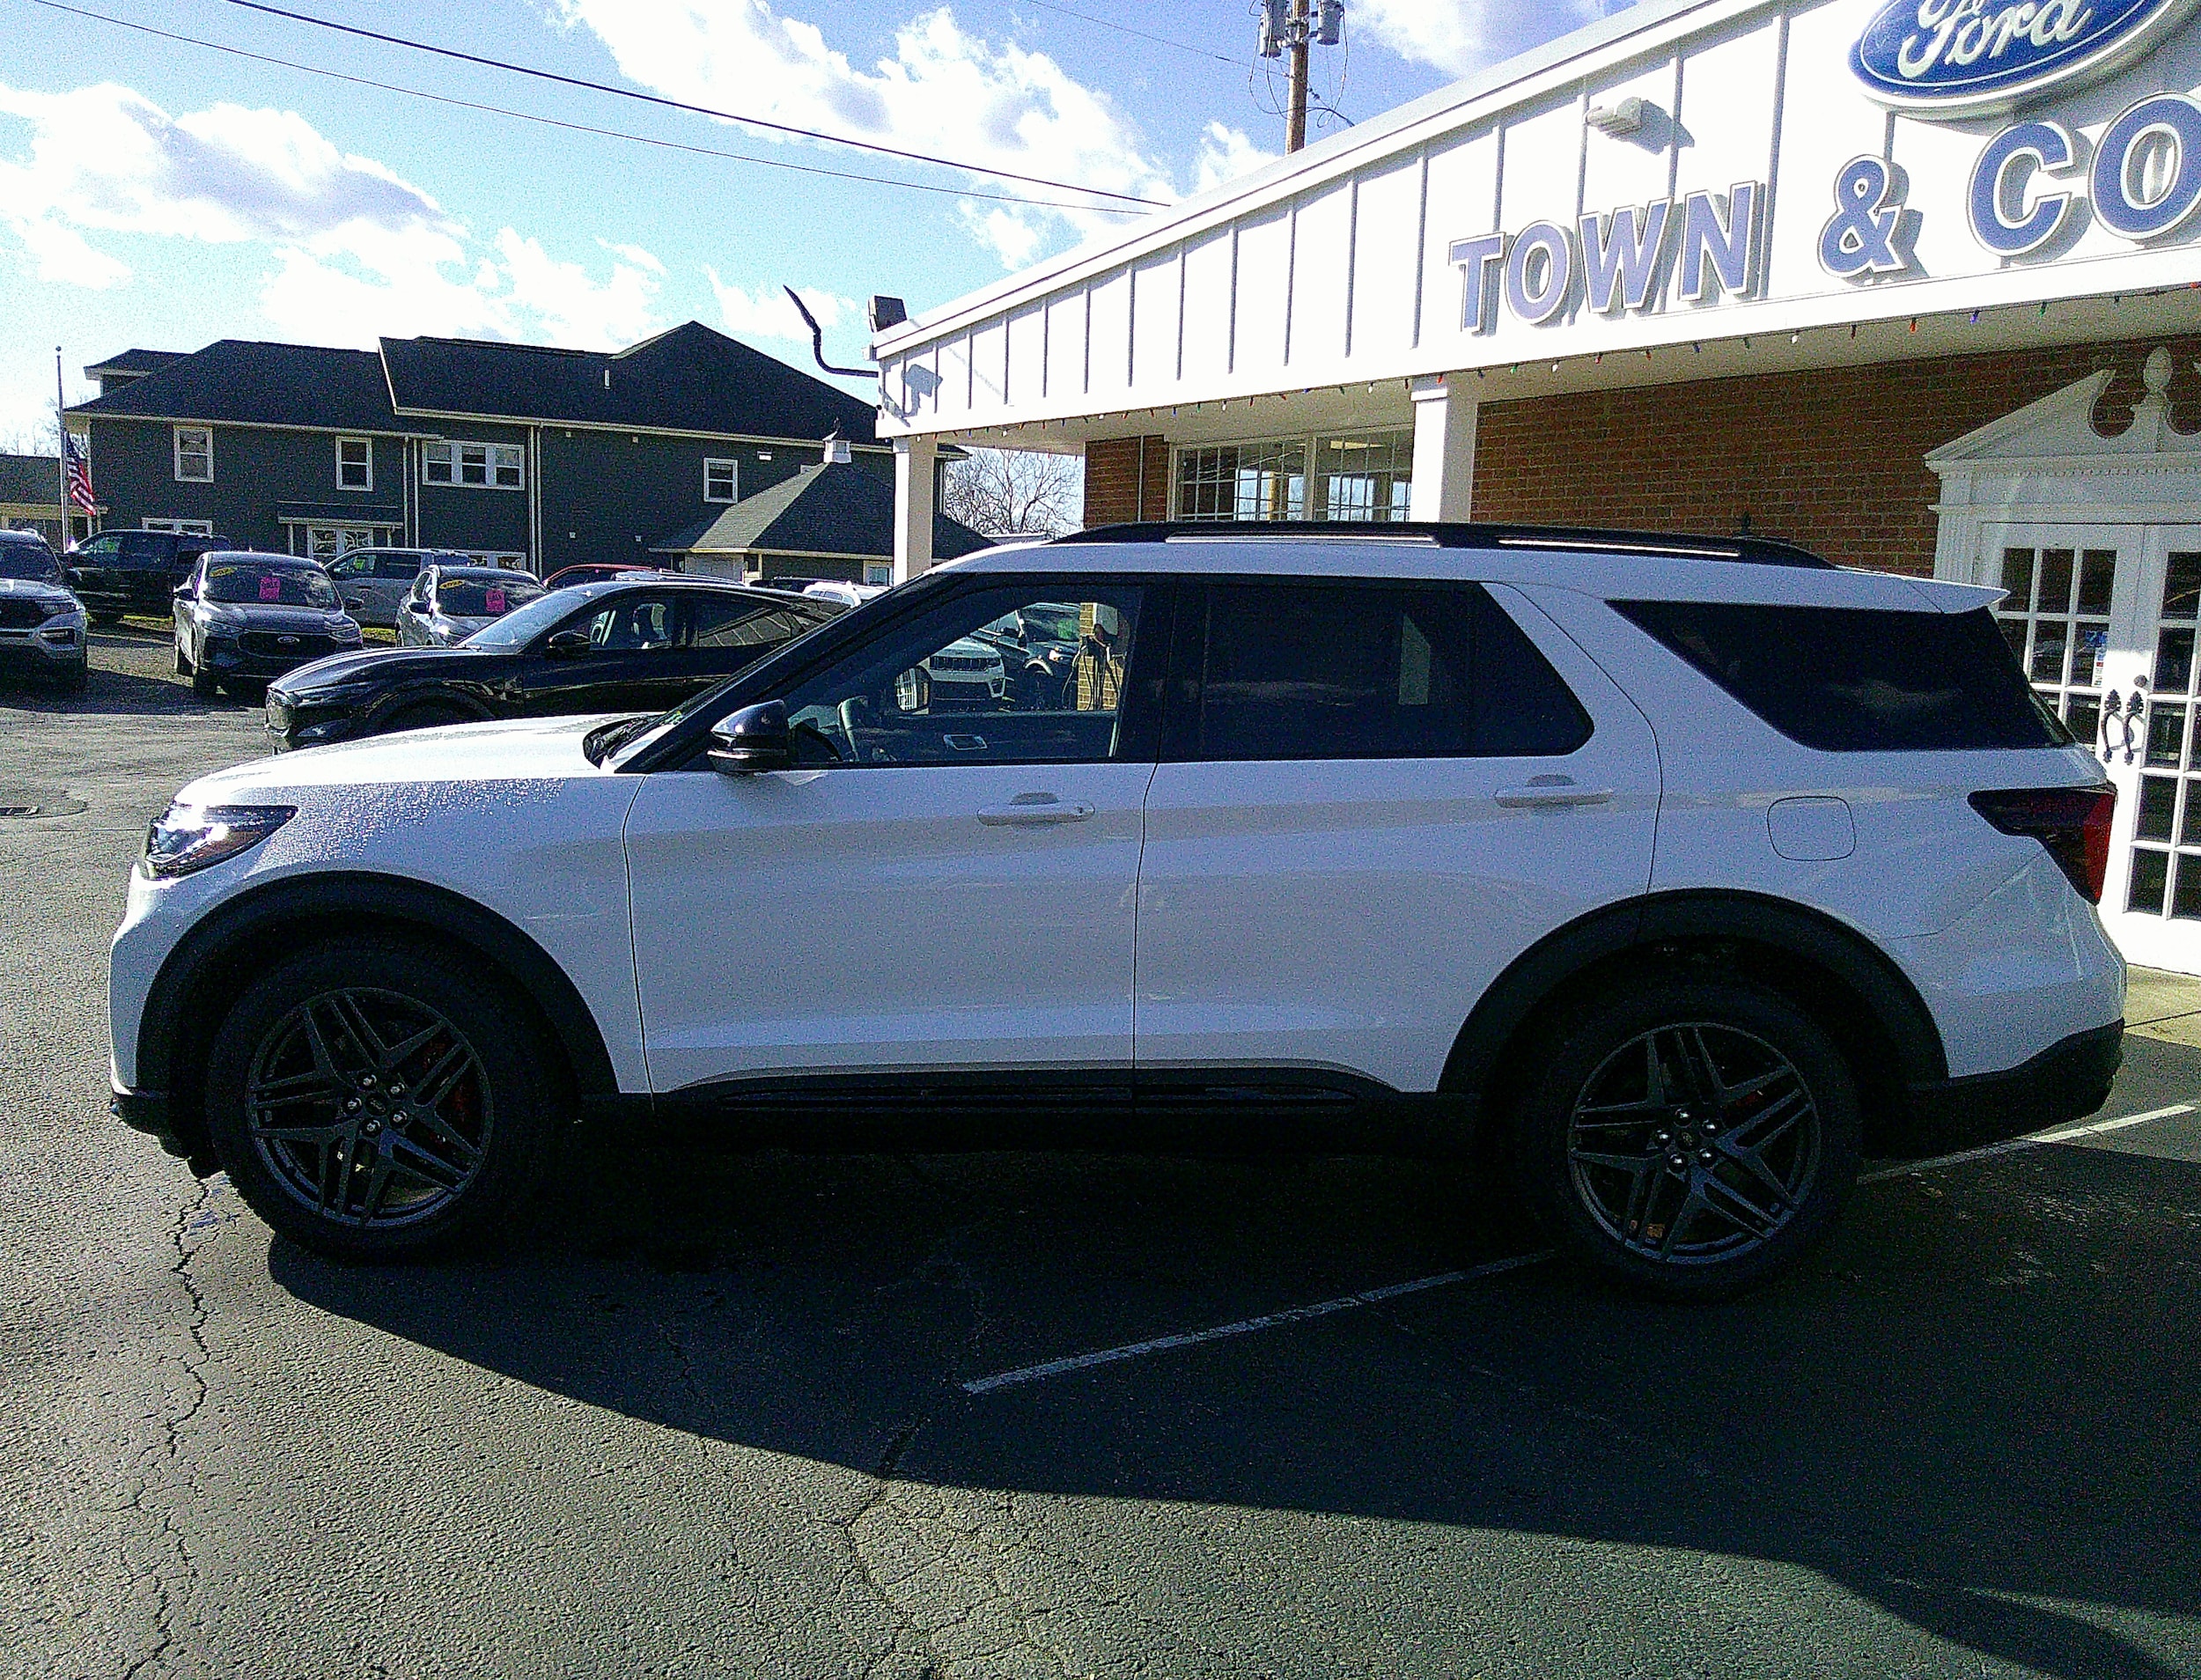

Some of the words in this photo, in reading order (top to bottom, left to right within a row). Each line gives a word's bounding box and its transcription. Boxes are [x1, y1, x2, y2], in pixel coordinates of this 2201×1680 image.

[1897, 0, 2093, 78] Ford
[1449, 180, 1759, 333] TOWN
[1817, 154, 1906, 278] &
